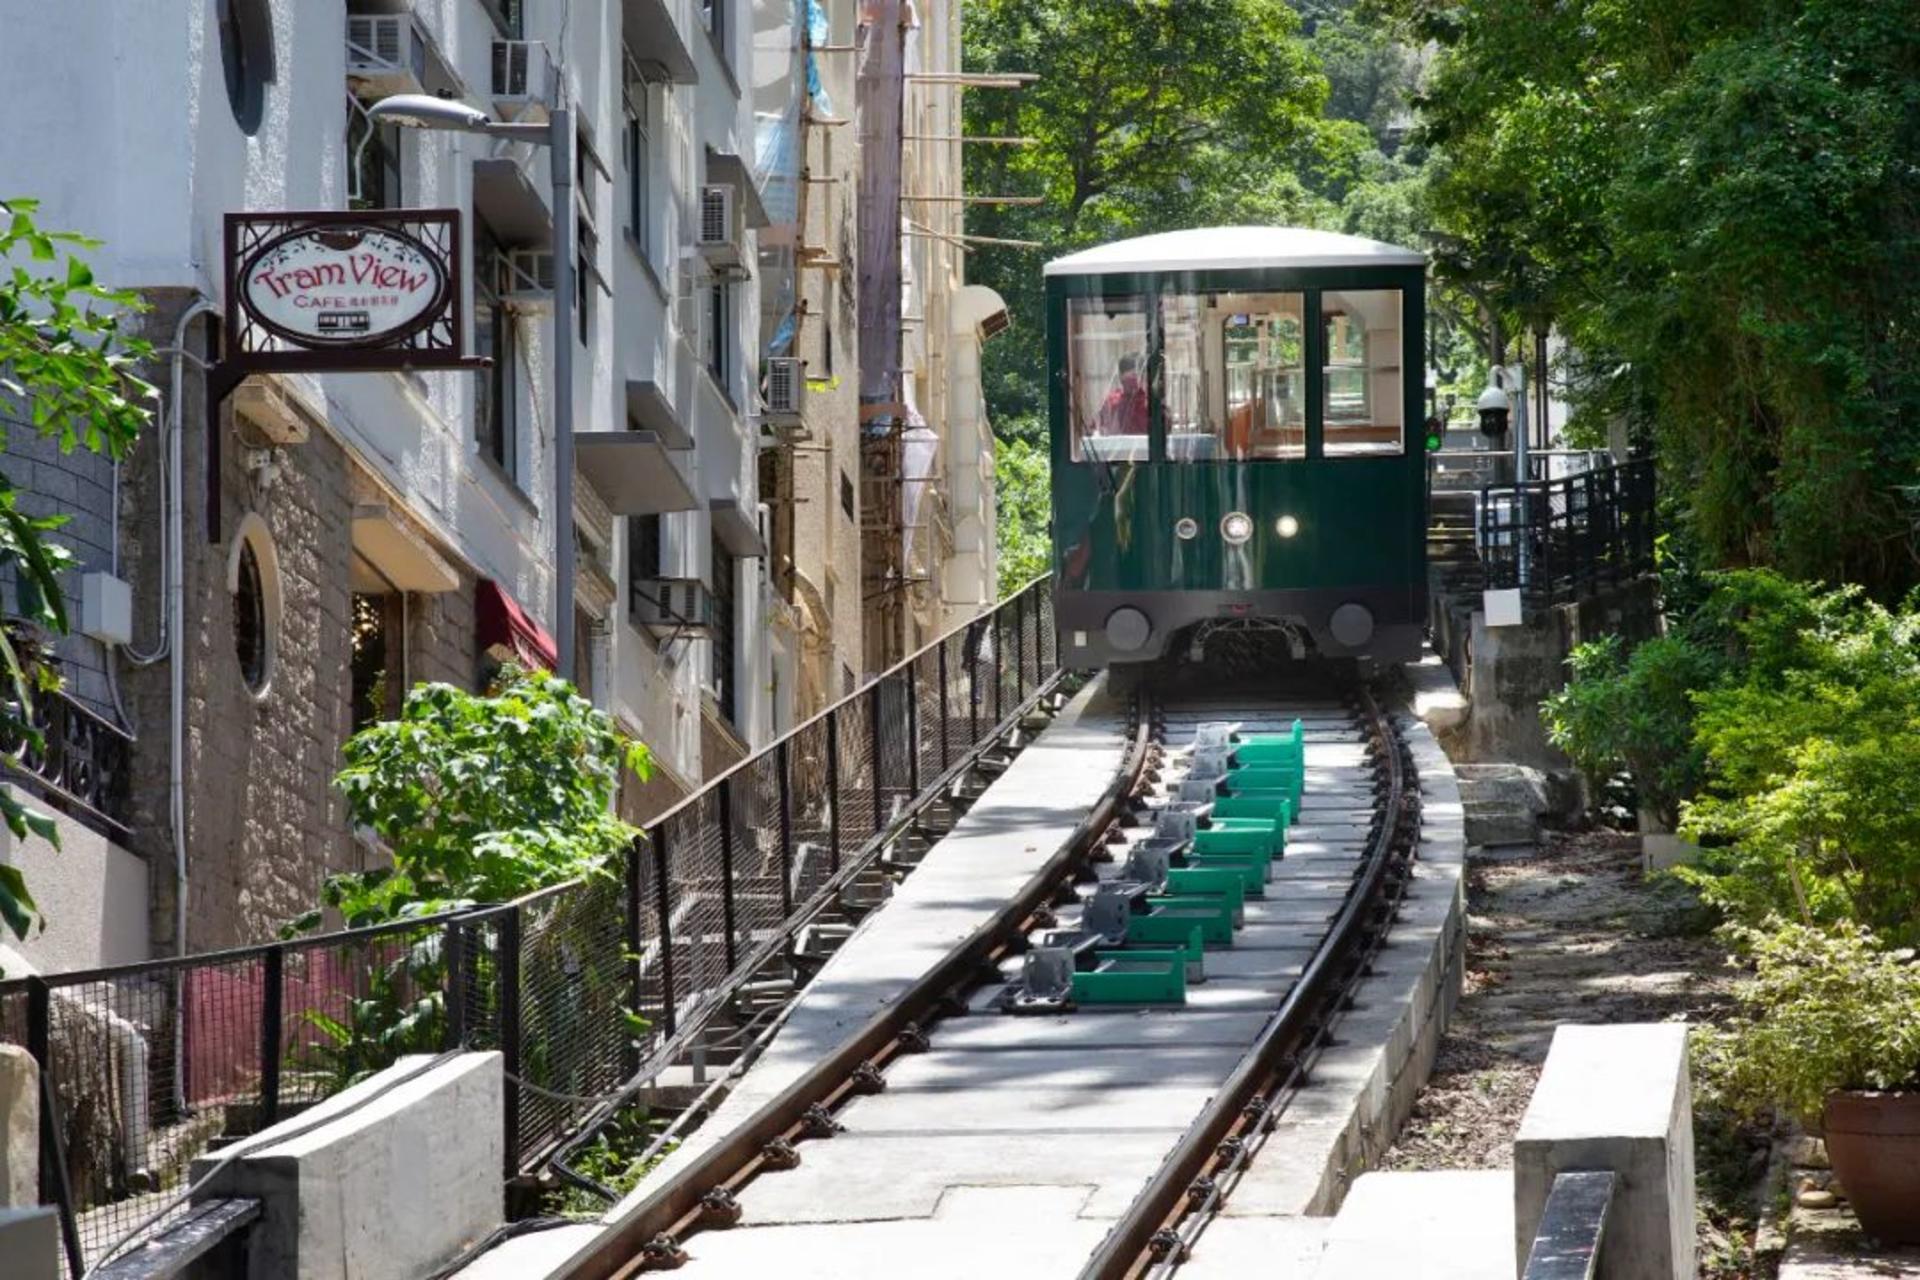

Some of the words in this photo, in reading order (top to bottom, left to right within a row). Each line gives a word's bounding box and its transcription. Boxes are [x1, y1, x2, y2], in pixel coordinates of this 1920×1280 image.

[253, 263, 345, 298] Tram
[349, 254, 428, 294] View
[293, 294, 347, 308] CAFE
